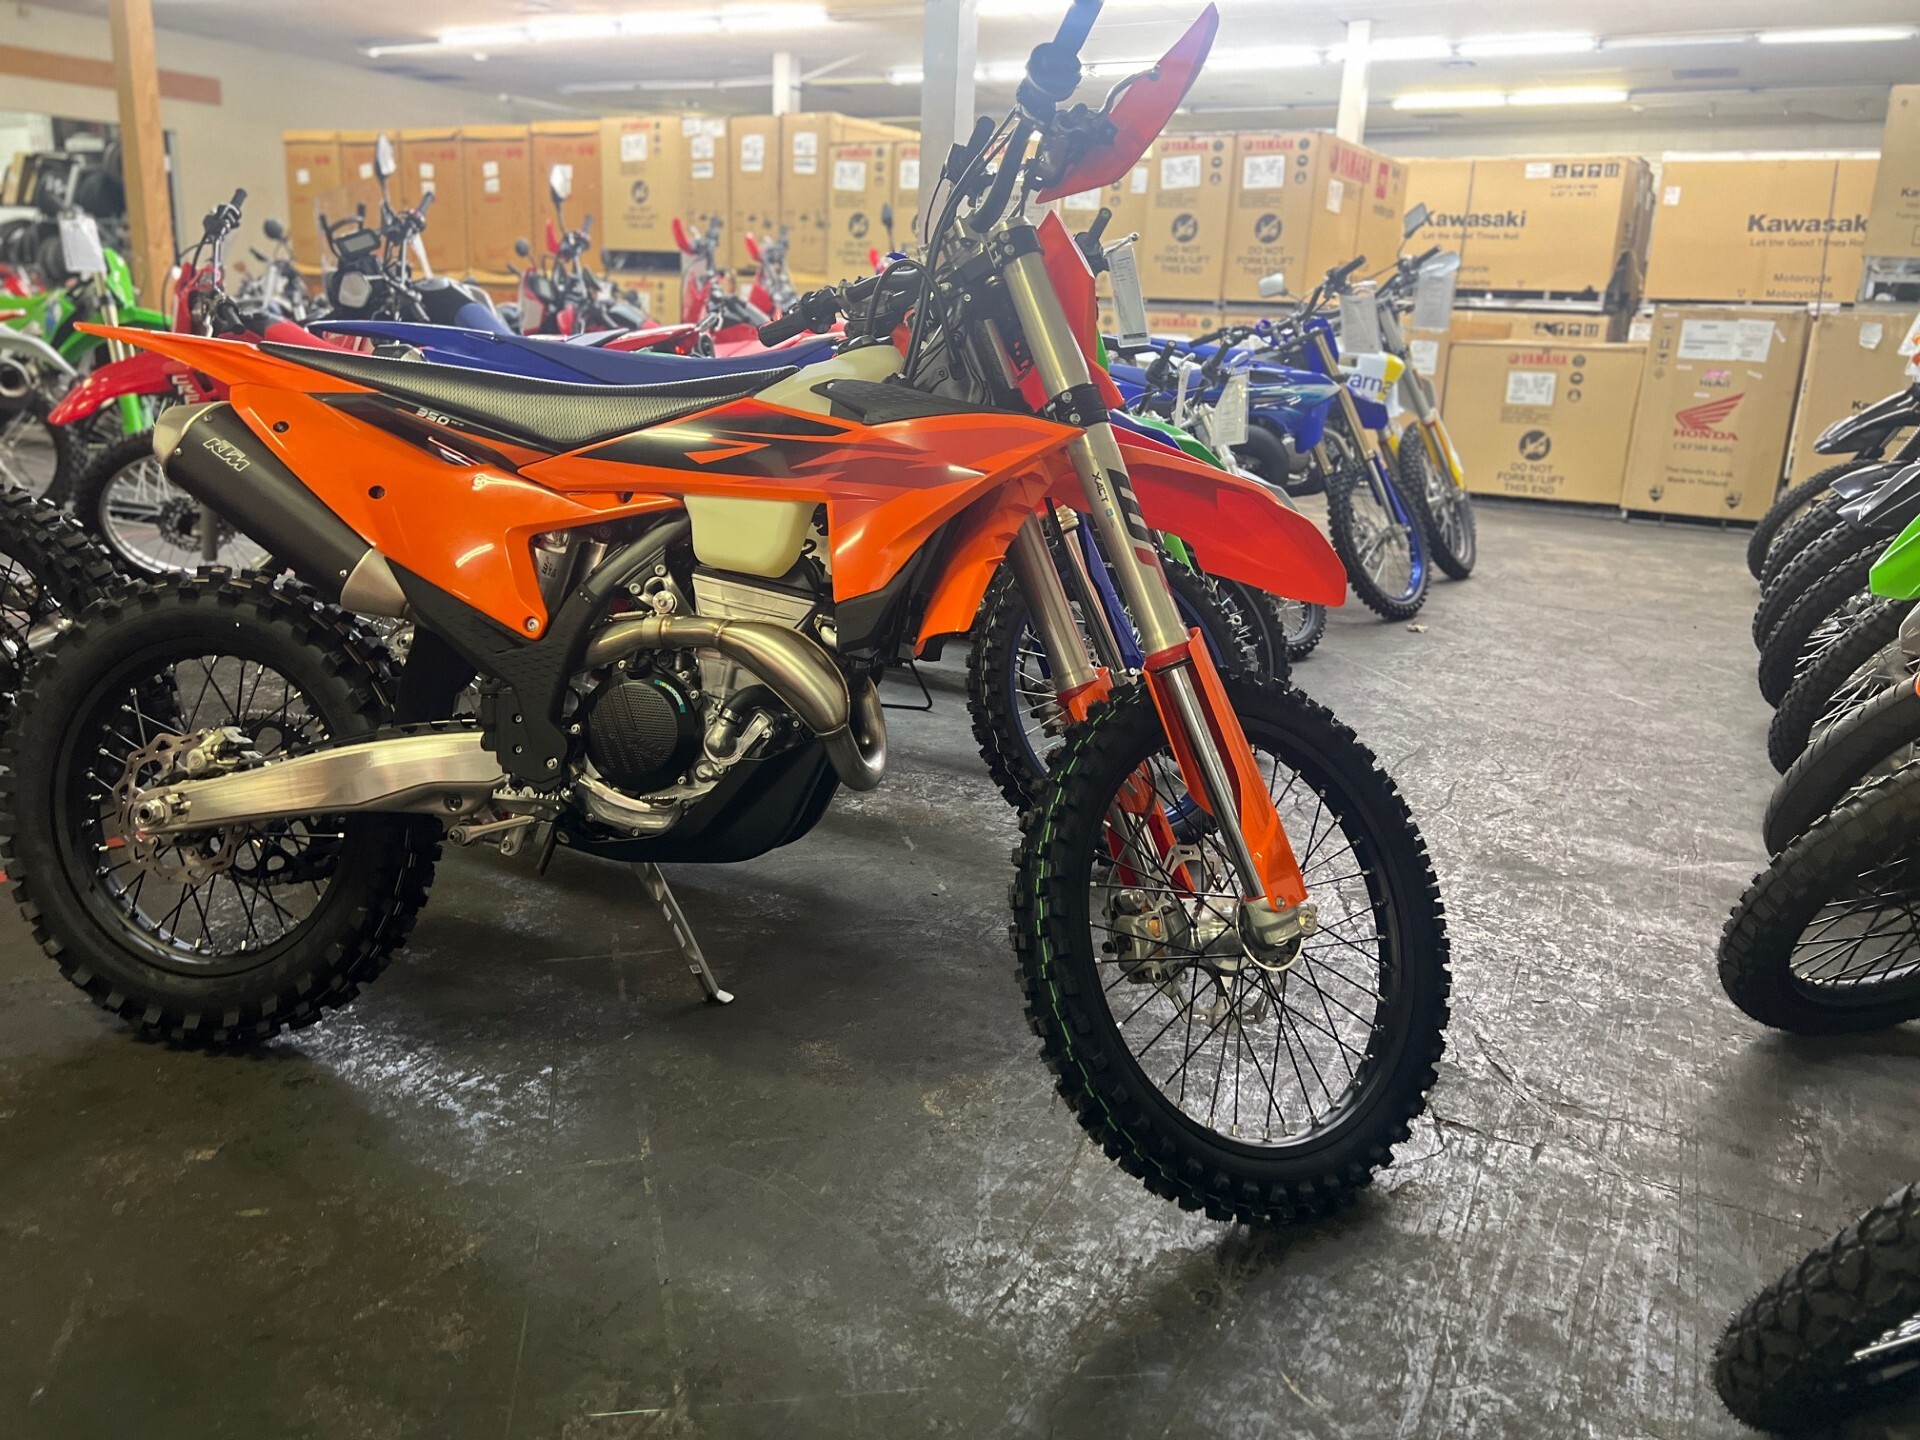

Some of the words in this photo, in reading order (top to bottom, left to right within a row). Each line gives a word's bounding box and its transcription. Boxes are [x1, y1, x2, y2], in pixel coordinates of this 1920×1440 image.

[1171, 141, 1209, 151] YAMAHA
[1255, 140, 1294, 149] YAMAHA
[1421, 210, 1527, 228] Kawasaki
[1747, 214, 1868, 232] Kawasak
[1422, 232, 1435, 240] Let
[1750, 238, 1766, 247] Let
[1769, 238, 1785, 247] the
[1787, 238, 1815, 247] Good
[1522, 354, 1567, 366] YAMAHA
[415, 407, 450, 426] 350
[1673, 429, 1739, 442] HONDA
[203, 437, 251, 472] KTM
[1510, 462, 1527, 472] DO
[1530, 463, 1554, 473] NOT
[1092, 471, 1109, 502] XACT
[1503, 482, 1529, 493] THIS
[1531, 484, 1555, 495] END
